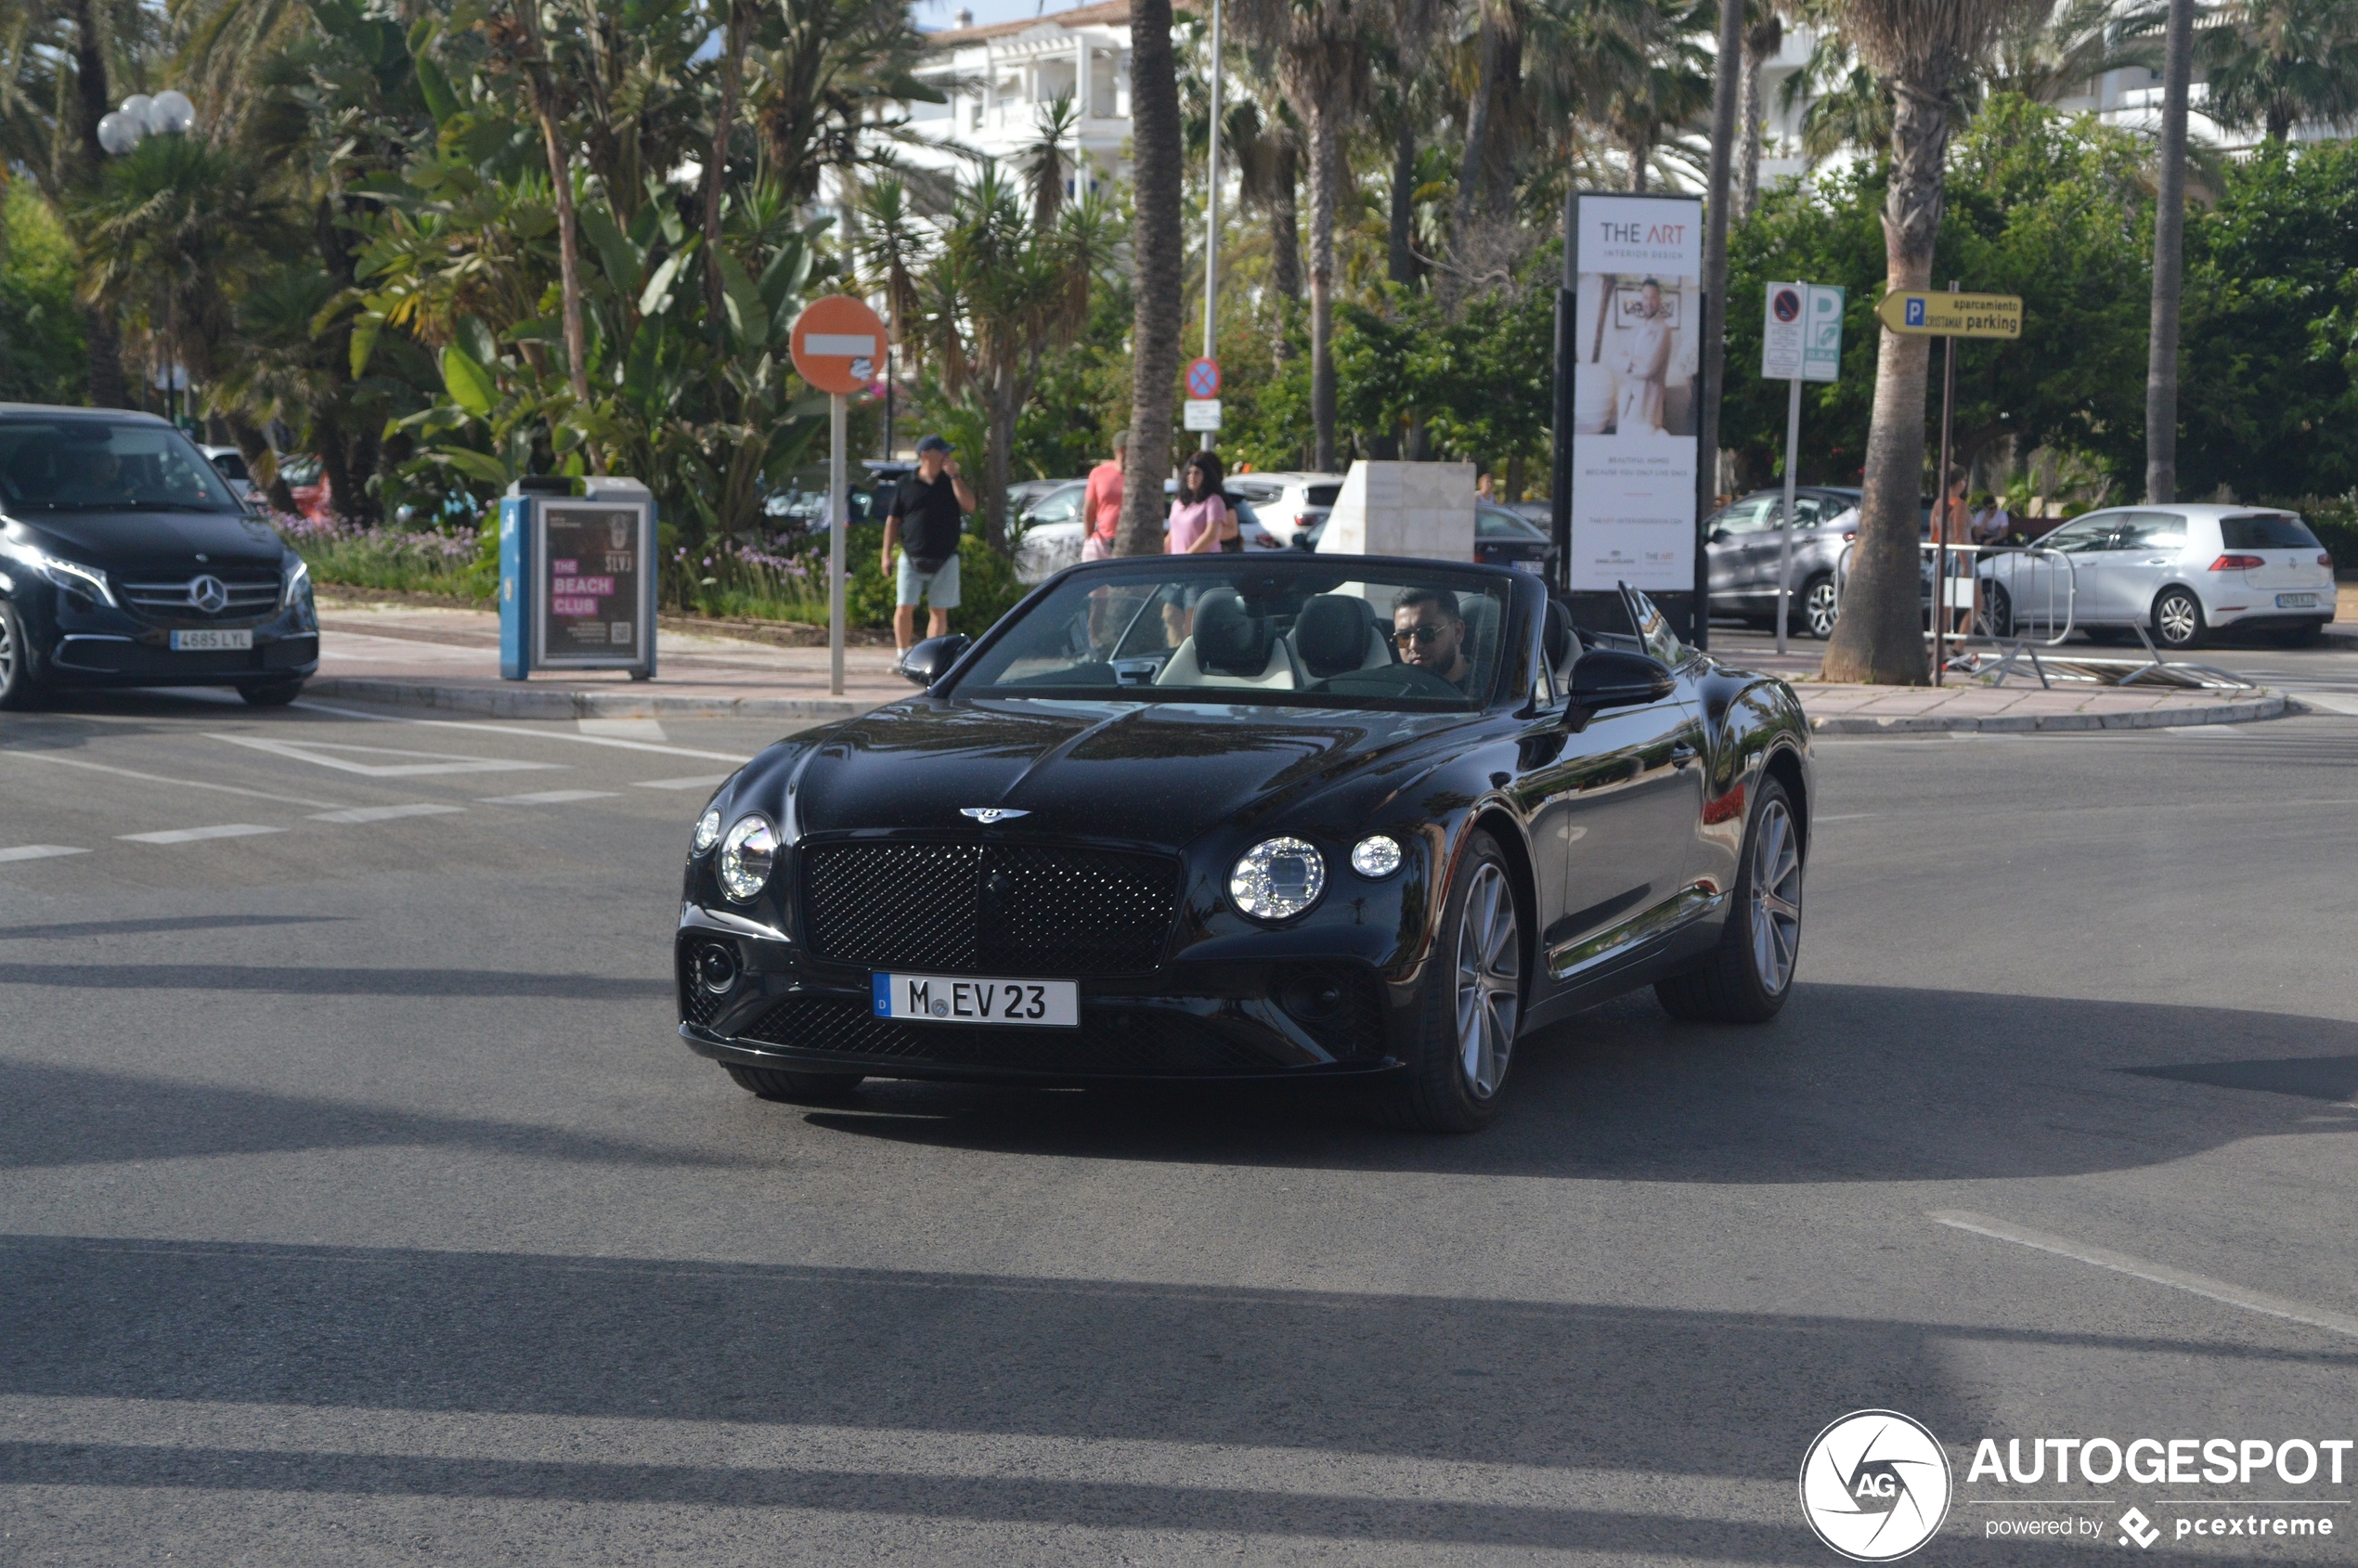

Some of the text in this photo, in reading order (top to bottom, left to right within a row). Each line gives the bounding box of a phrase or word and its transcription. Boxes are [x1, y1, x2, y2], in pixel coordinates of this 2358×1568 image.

[1601, 222, 1686, 244] THE ART
[1603, 249, 1684, 260] INTERIOR DESIGN
[1909, 301, 1921, 323] P
[1953, 299, 2018, 313] aparcamiento
[1925, 312, 2017, 333] CRISTAMAR parking
[553, 561, 577, 573] THE
[554, 577, 610, 593] BEACH
[553, 598, 595, 613] CLUB
[181, 632, 247, 647] 4685 LYL
[878, 999, 887, 1010] D
[908, 979, 1045, 1018] M EV 23
